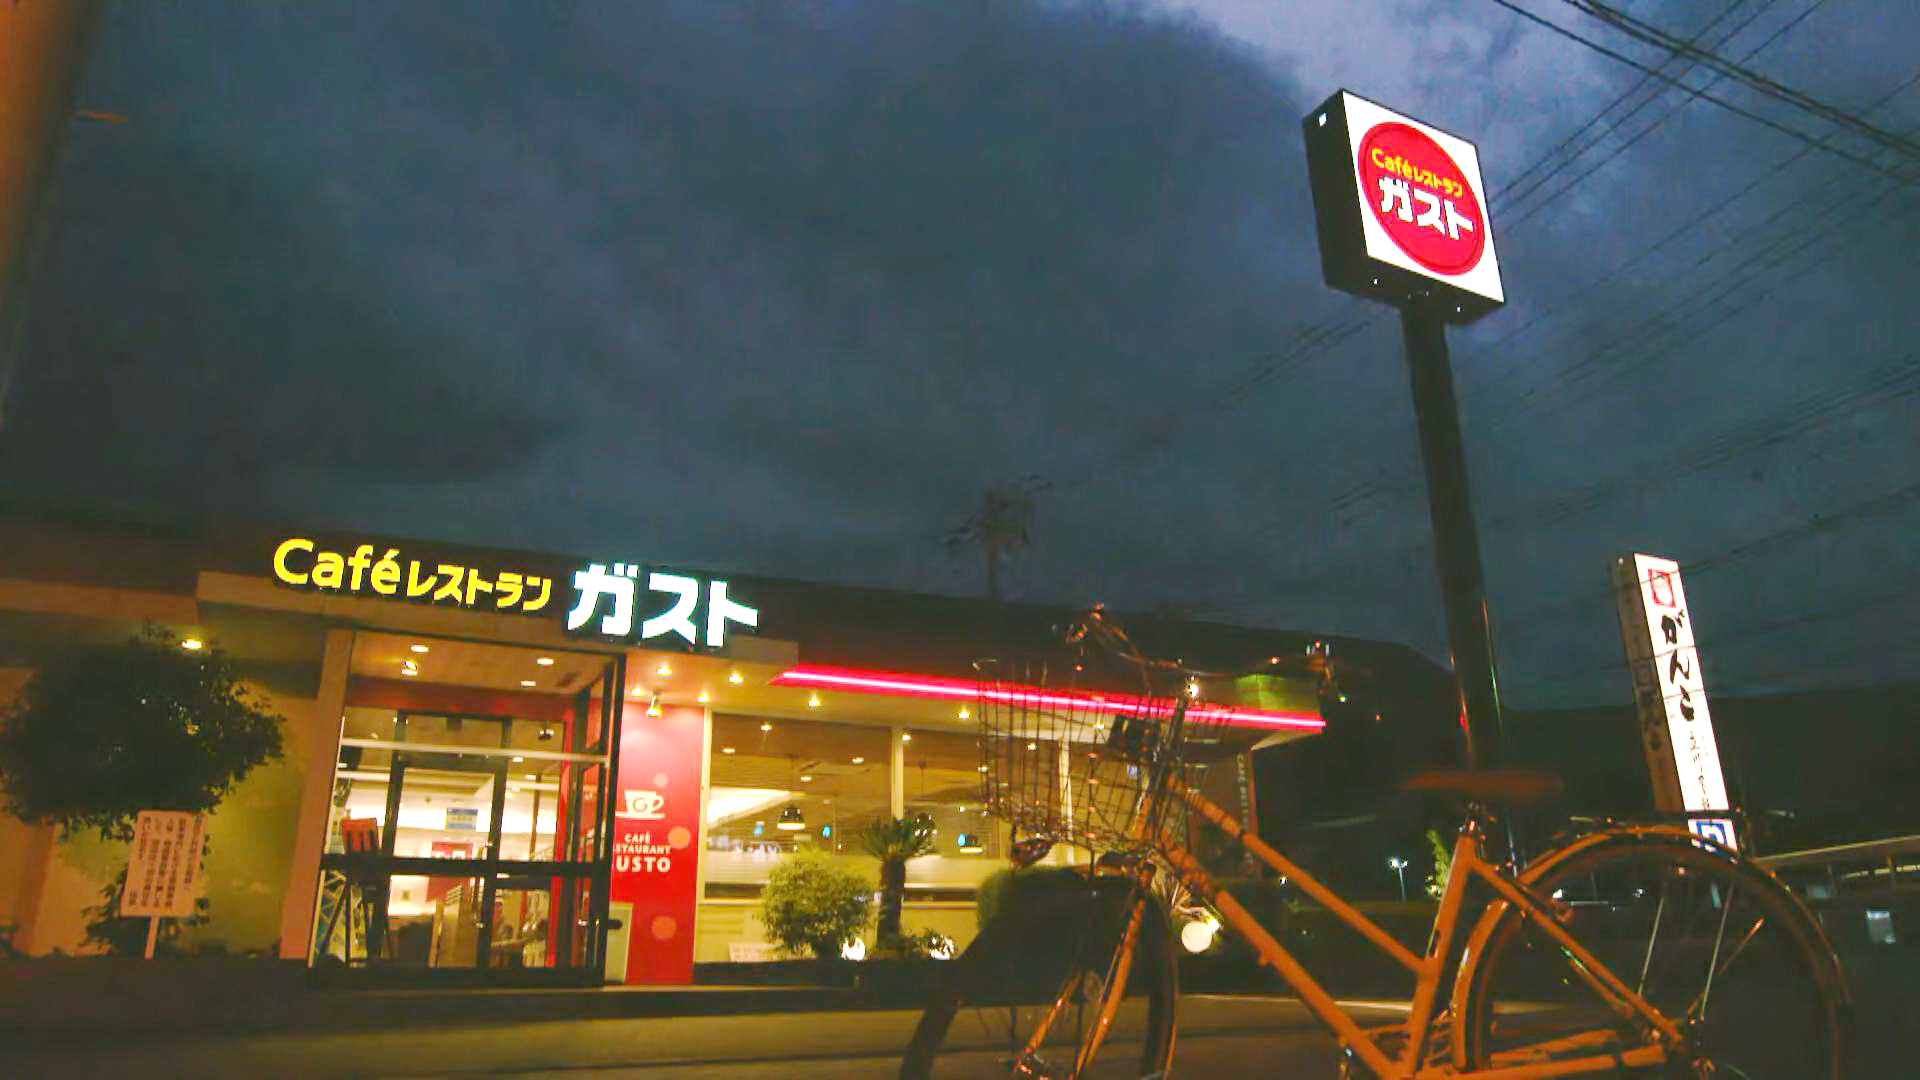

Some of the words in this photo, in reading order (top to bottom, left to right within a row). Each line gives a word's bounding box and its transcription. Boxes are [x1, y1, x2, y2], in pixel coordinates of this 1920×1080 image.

[1378, 176, 1474, 241] ガスト
[567, 562, 759, 647] ガスト
[615, 854, 671, 872] USTO
